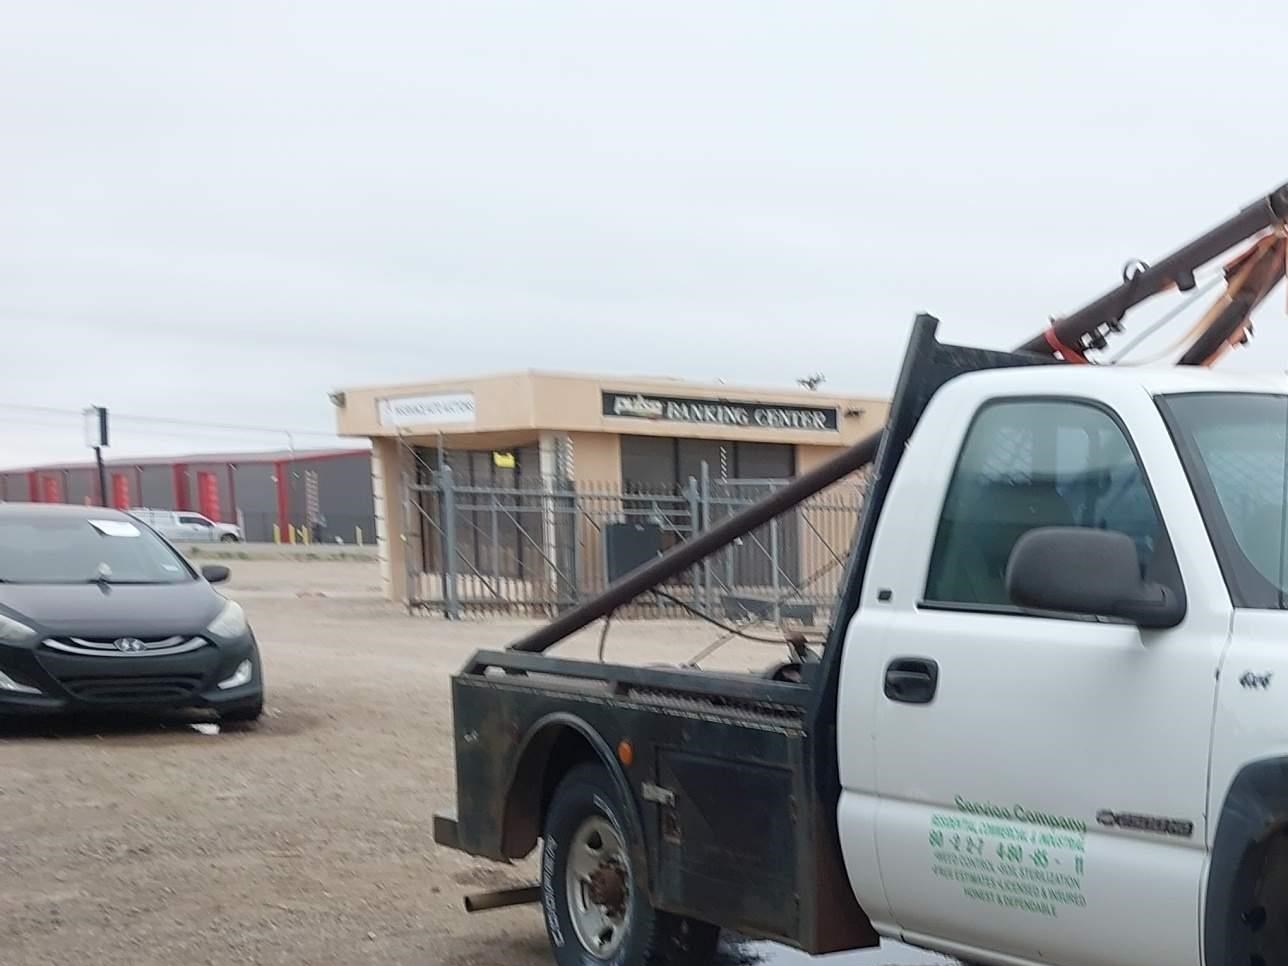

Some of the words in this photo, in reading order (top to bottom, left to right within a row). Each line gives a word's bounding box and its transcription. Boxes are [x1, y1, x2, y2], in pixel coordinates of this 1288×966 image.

[666, 401, 750, 426] BANKING
[753, 408, 827, 429] CENTER
[1013, 804, 1087, 832] Company
